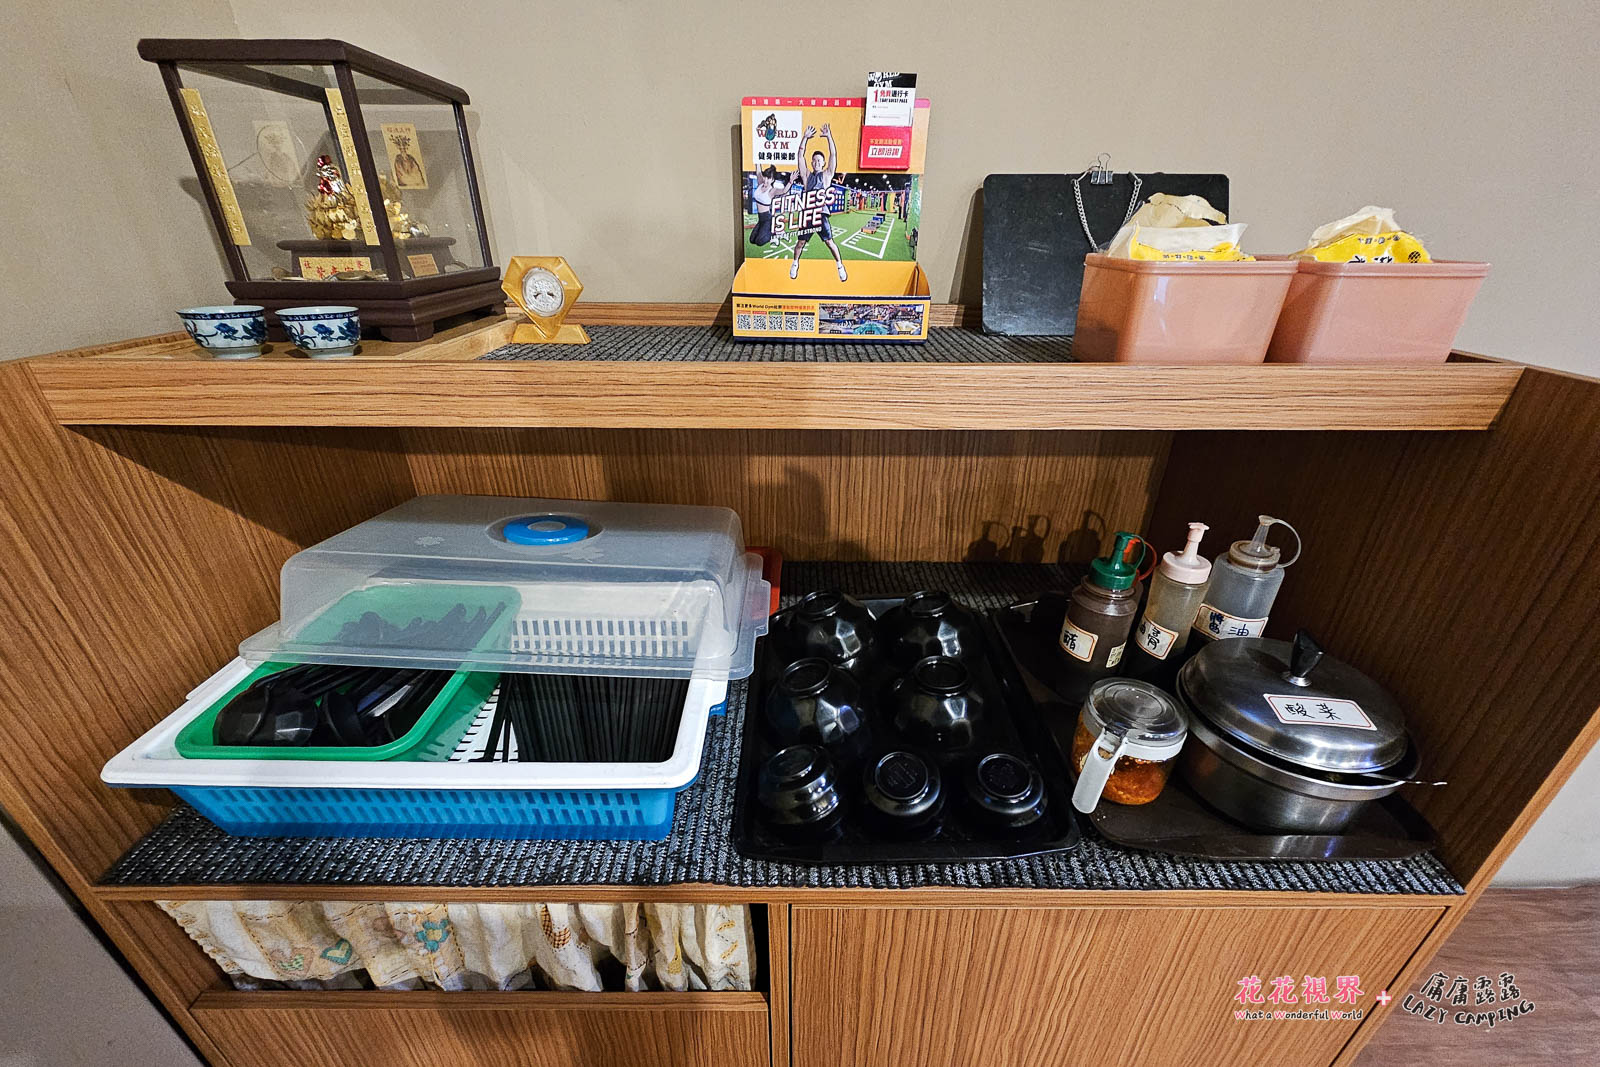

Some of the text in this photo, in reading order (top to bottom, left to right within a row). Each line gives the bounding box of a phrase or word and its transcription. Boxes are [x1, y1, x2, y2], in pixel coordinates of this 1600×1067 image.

[757, 128, 798, 140] WORLD
[764, 141, 790, 150] GYM
[758, 151, 796, 161] 健身俱樂部
[771, 187, 836, 216] FITNESS
[771, 208, 823, 234] IS LIFE
